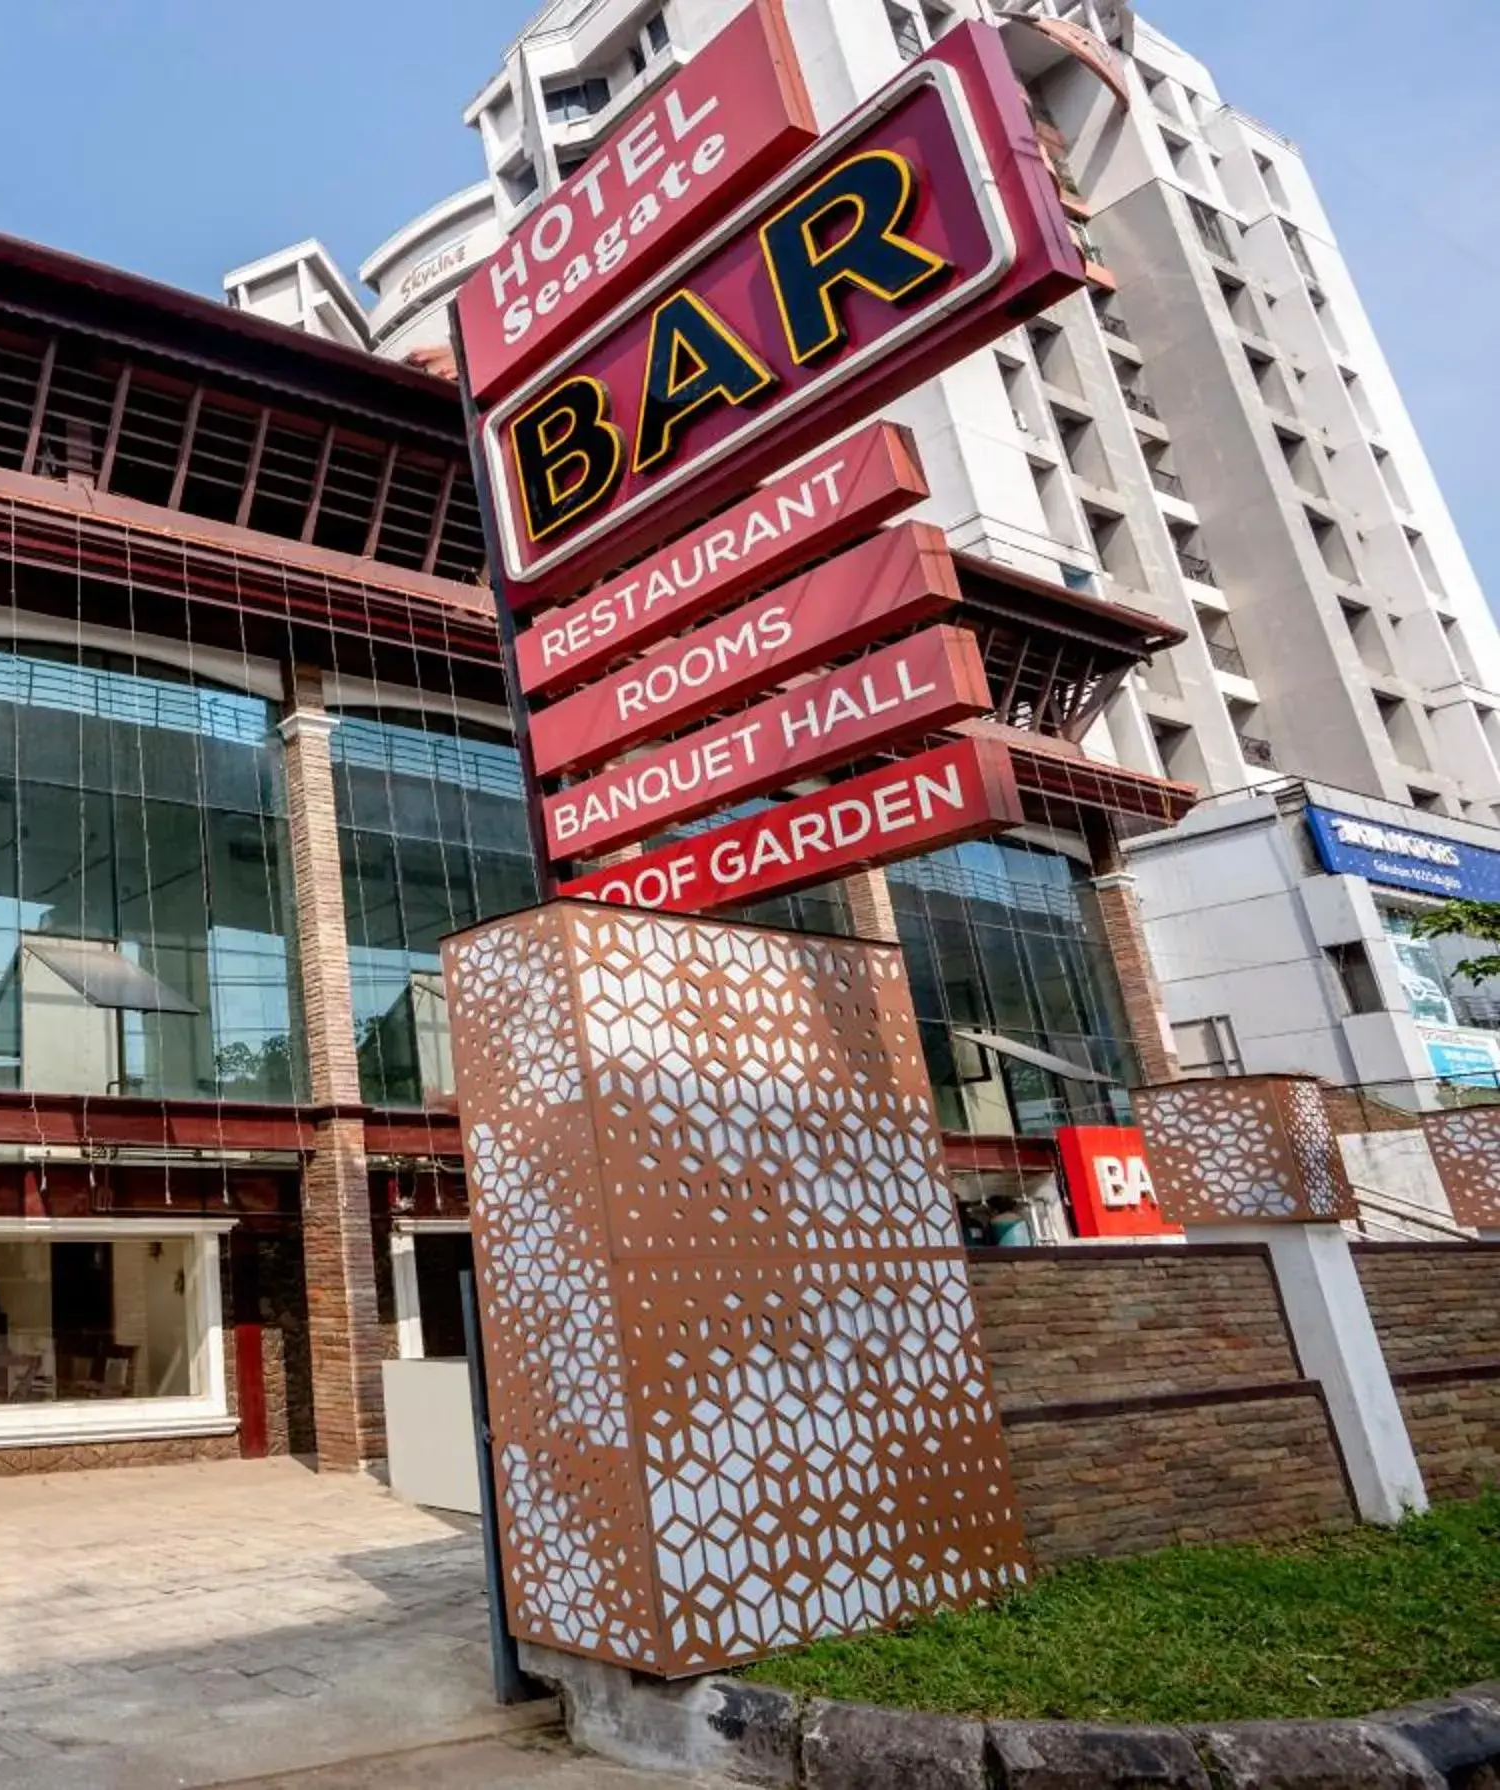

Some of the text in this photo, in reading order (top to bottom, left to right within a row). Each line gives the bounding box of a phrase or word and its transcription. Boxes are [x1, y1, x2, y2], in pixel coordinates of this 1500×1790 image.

[489, 88, 720, 308] HOTEL
[502, 133, 726, 345] Seagate
[510, 148, 948, 543] BAR
[541, 461, 845, 667] RESTAURANT
[553, 659, 937, 841] BANQUET HALL
[615, 607, 793, 720] ROOMS
[574, 766, 966, 909] OOF GARDEN
[1092, 1155, 1160, 1207] BA
